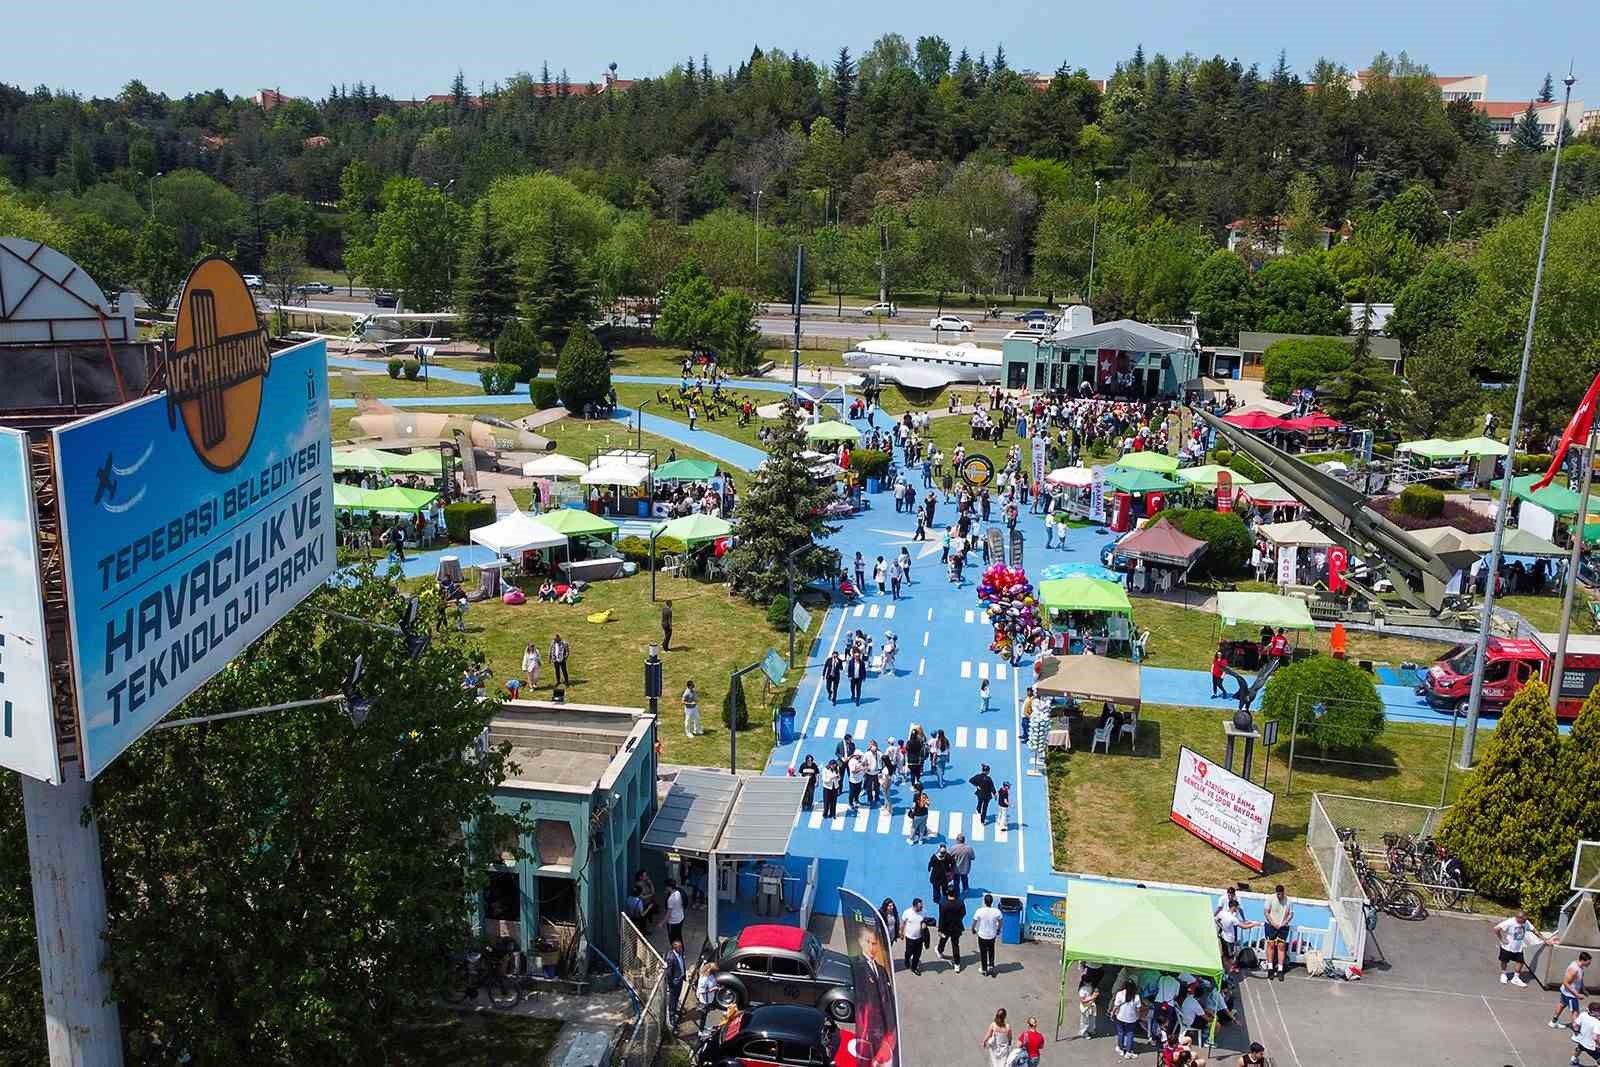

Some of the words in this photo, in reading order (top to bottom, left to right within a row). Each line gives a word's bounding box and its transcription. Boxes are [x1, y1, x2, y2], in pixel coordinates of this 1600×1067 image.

[98, 496, 218, 593] TEPEBAŞI
[223, 440, 321, 521] BELEDİYESİ
[105, 510, 287, 676] HAVACILIK
[291, 486, 323, 541] VE
[107, 582, 260, 727] TEKNOLOJİ
[264, 534, 324, 606] PARKI
[1215, 794, 1231, 809] SPOR
